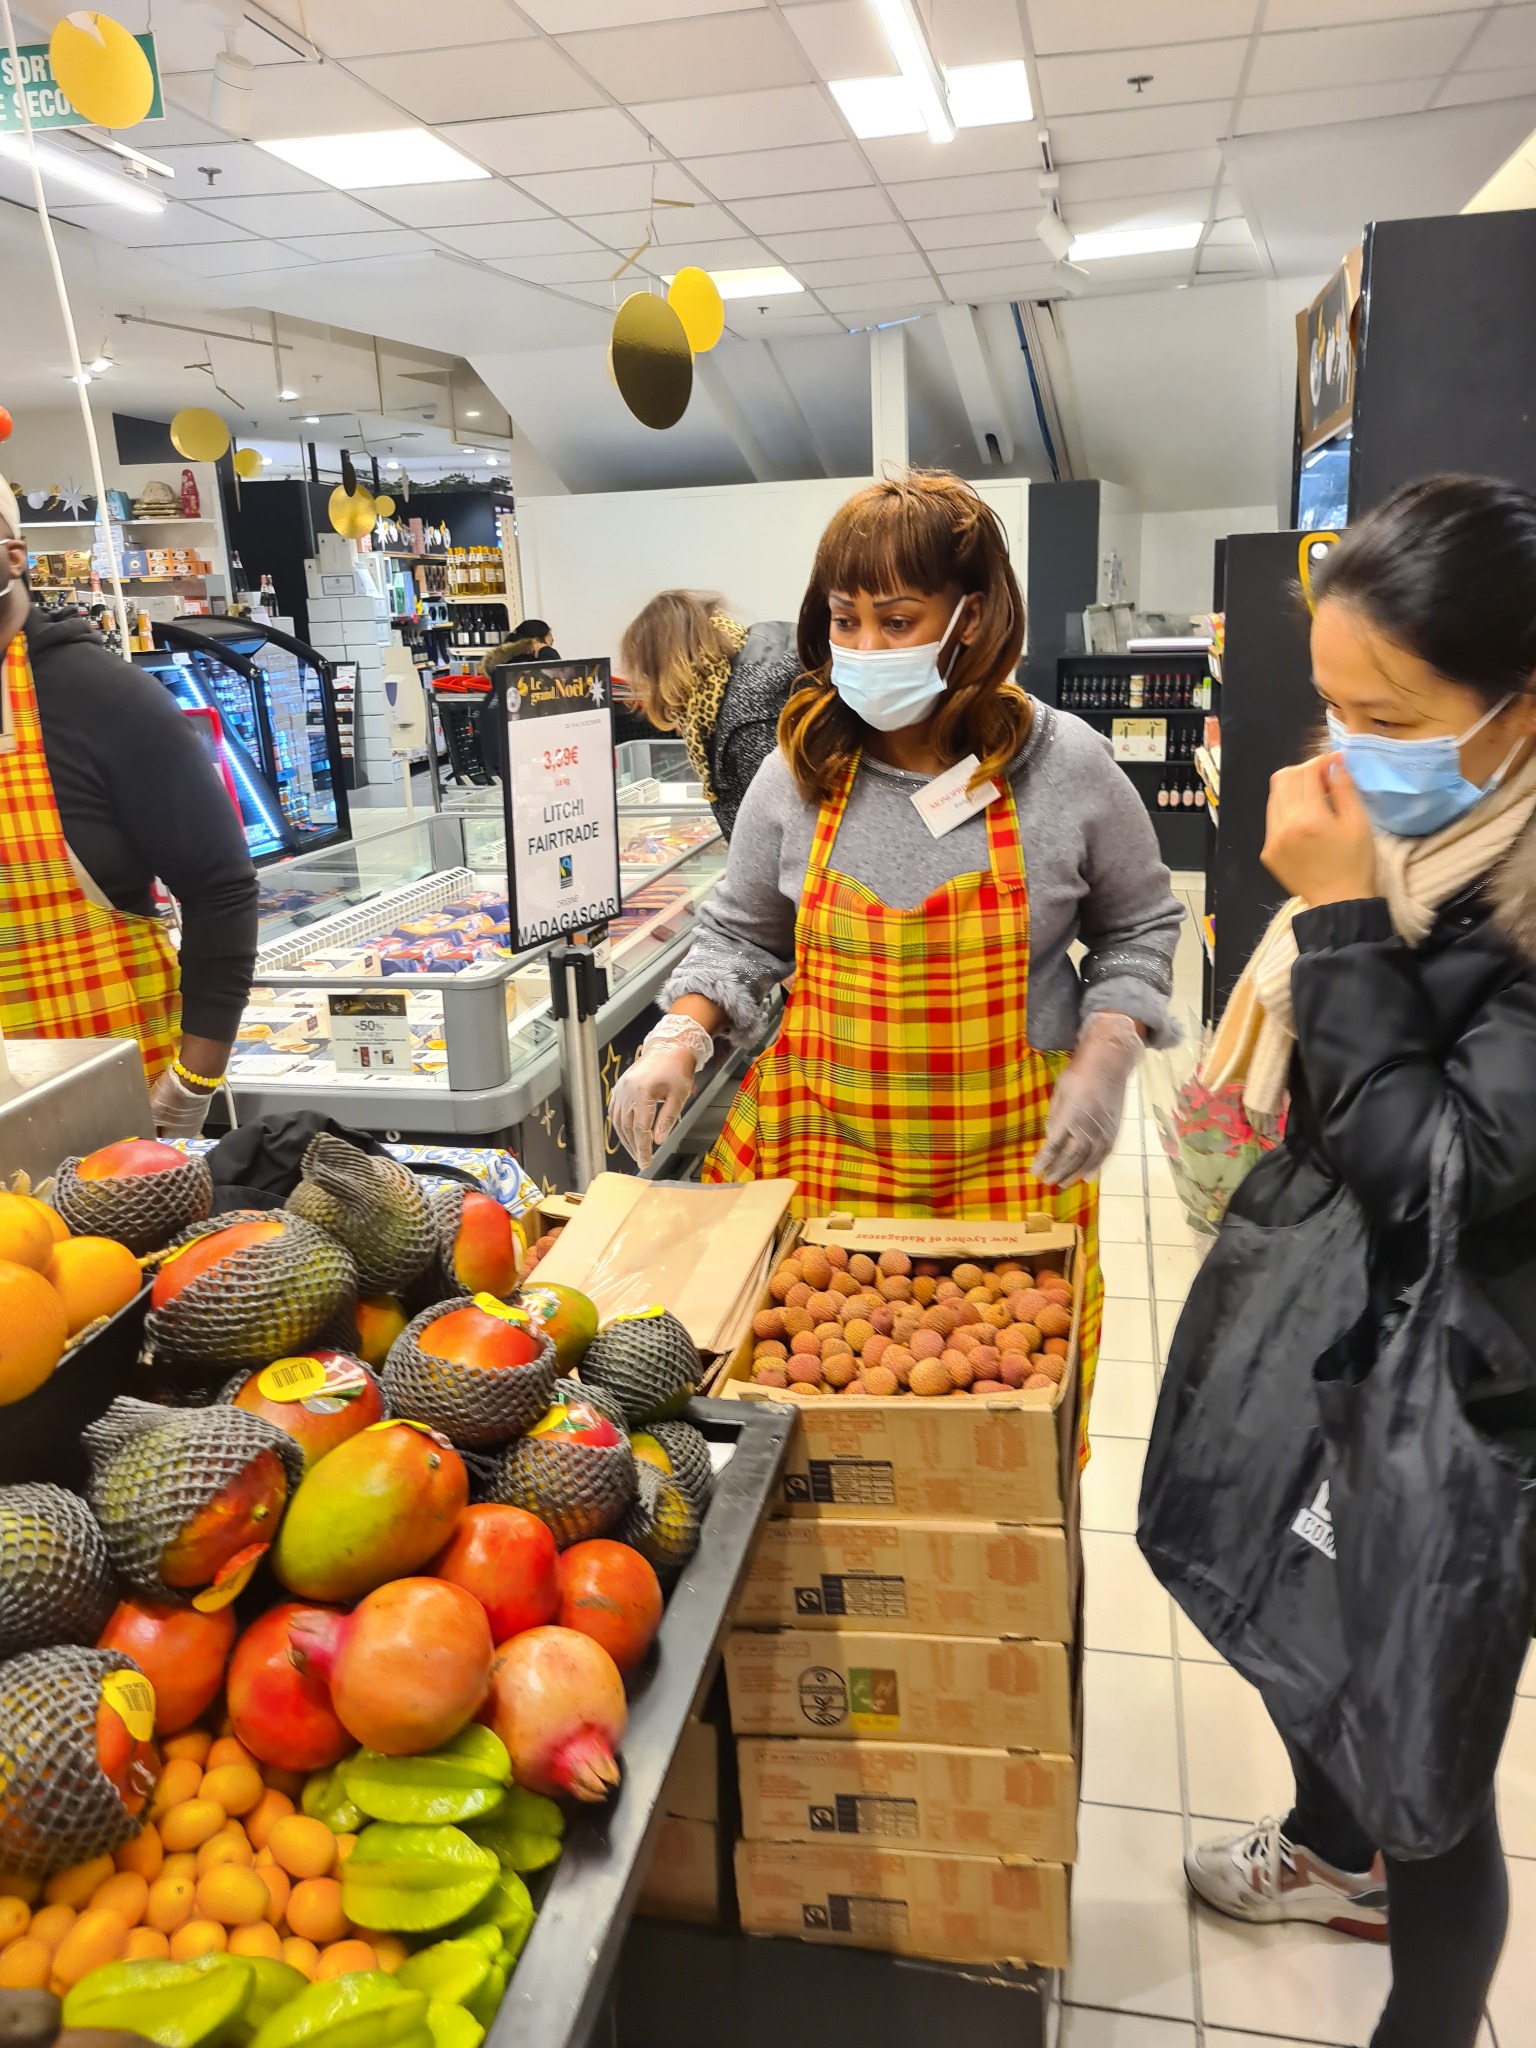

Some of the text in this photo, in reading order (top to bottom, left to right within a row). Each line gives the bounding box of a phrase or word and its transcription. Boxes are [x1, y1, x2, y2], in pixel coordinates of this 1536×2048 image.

[13, 88, 80, 119] SECO
[530, 676, 542, 690] Le
[530, 676, 584, 707] grand Noël
[543, 798, 584, 823] LITCHI
[528, 821, 600, 856] FAIRTRADE
[517, 897, 616, 948] MADAGASCAR
[854, 1233, 1018, 1244] New Lychee of Madagascar
